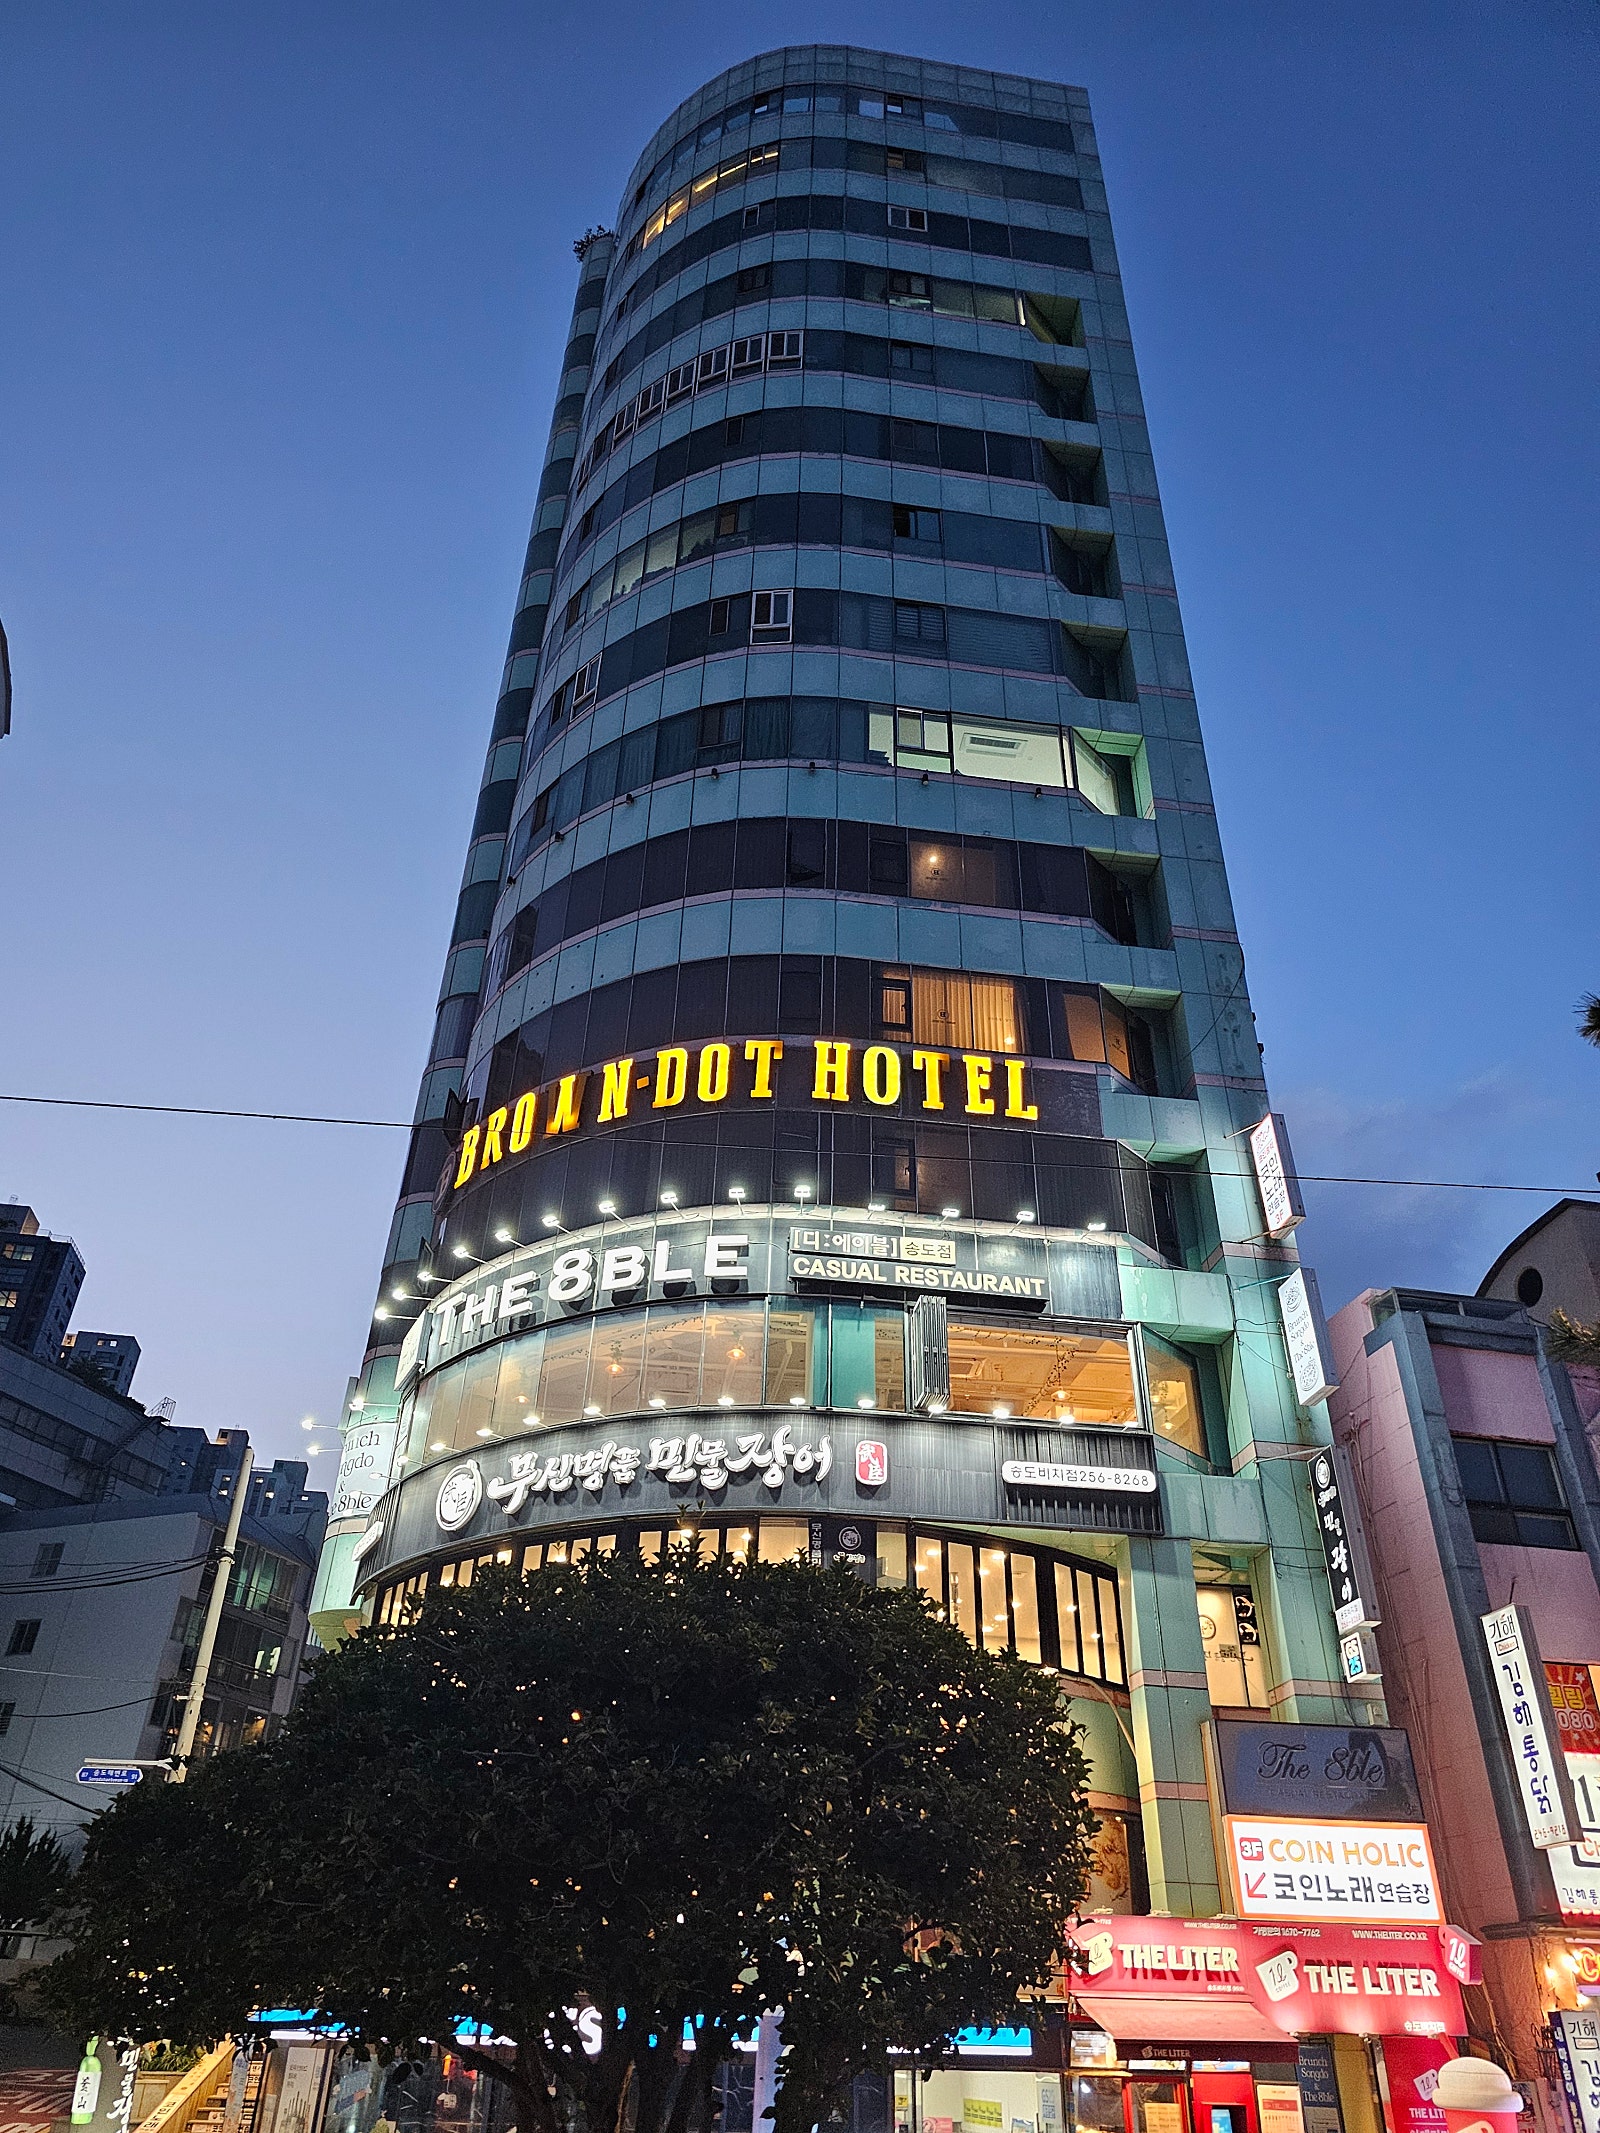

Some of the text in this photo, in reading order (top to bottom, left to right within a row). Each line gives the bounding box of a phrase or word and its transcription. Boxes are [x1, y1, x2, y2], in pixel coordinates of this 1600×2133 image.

[454, 1039, 783, 1190] BROWN-DOT
[813, 1040, 1039, 1122] HOTEL
[904, 1240, 952, 1259] 송도점
[792, 1257, 1047, 1297] CASUAL RESTAURANT
[436, 1234, 750, 1347] THE 8BLE
[646, 1424, 834, 1490] 민물장어
[1345, 1640, 1360, 1660] GS
[1349, 1655, 1362, 1676] 25
[1502, 1661, 1553, 1815] 김해통닭
[1257, 1740, 1384, 1783] The 8ble
[1240, 1838, 1425, 1868] 3F COIN HOLIC
[1281, 1927, 1321, 1938] 1670-7762
[1352, 1929, 1429, 1941] WWW.THELITER.CO.KR
[1303, 1964, 1442, 1997] THE LITER
[1153, 2048, 1191, 2058] THE LITER
[1298, 2055, 1329, 2067] Brunch
[1301, 2067, 1329, 2082] Songdo
[1408, 2107, 1429, 2119] THE
